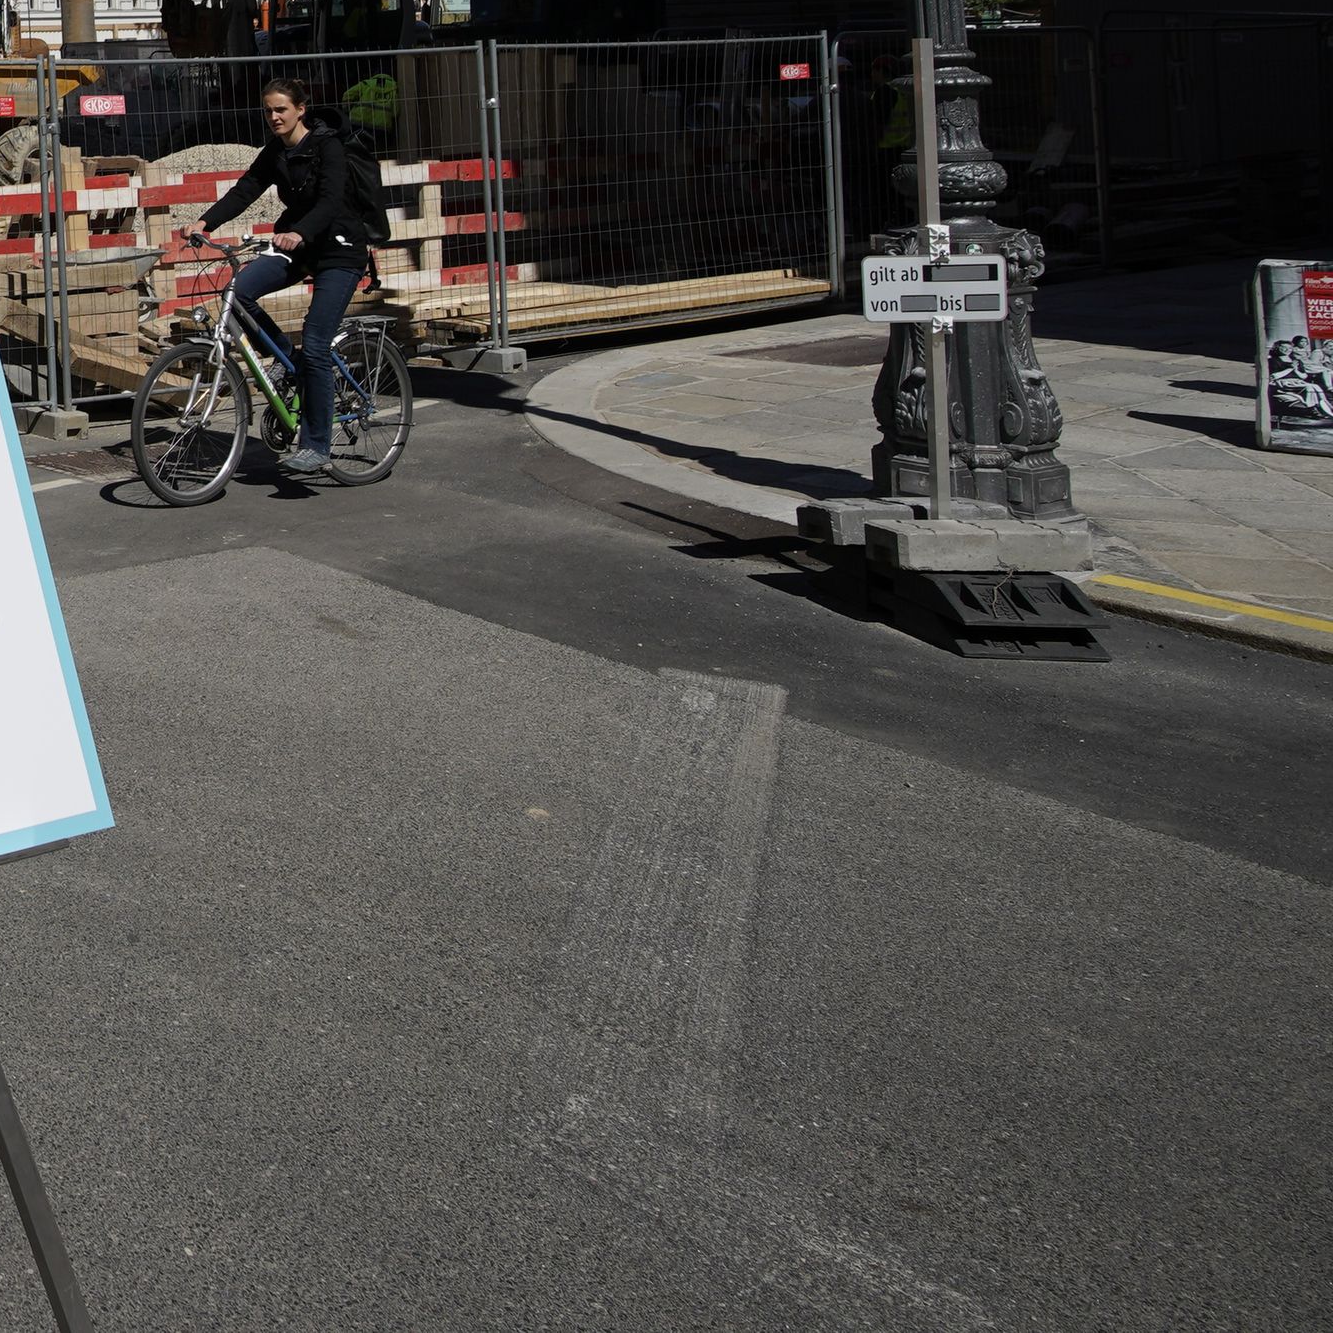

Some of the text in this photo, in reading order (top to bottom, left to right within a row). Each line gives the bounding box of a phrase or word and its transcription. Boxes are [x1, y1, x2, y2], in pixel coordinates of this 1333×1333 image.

[85, 99, 110, 112] EKRO
[869, 266, 919, 285] gilt ab
[871, 295, 962, 312] von bis
[1307, 298, 1333, 306] WER
